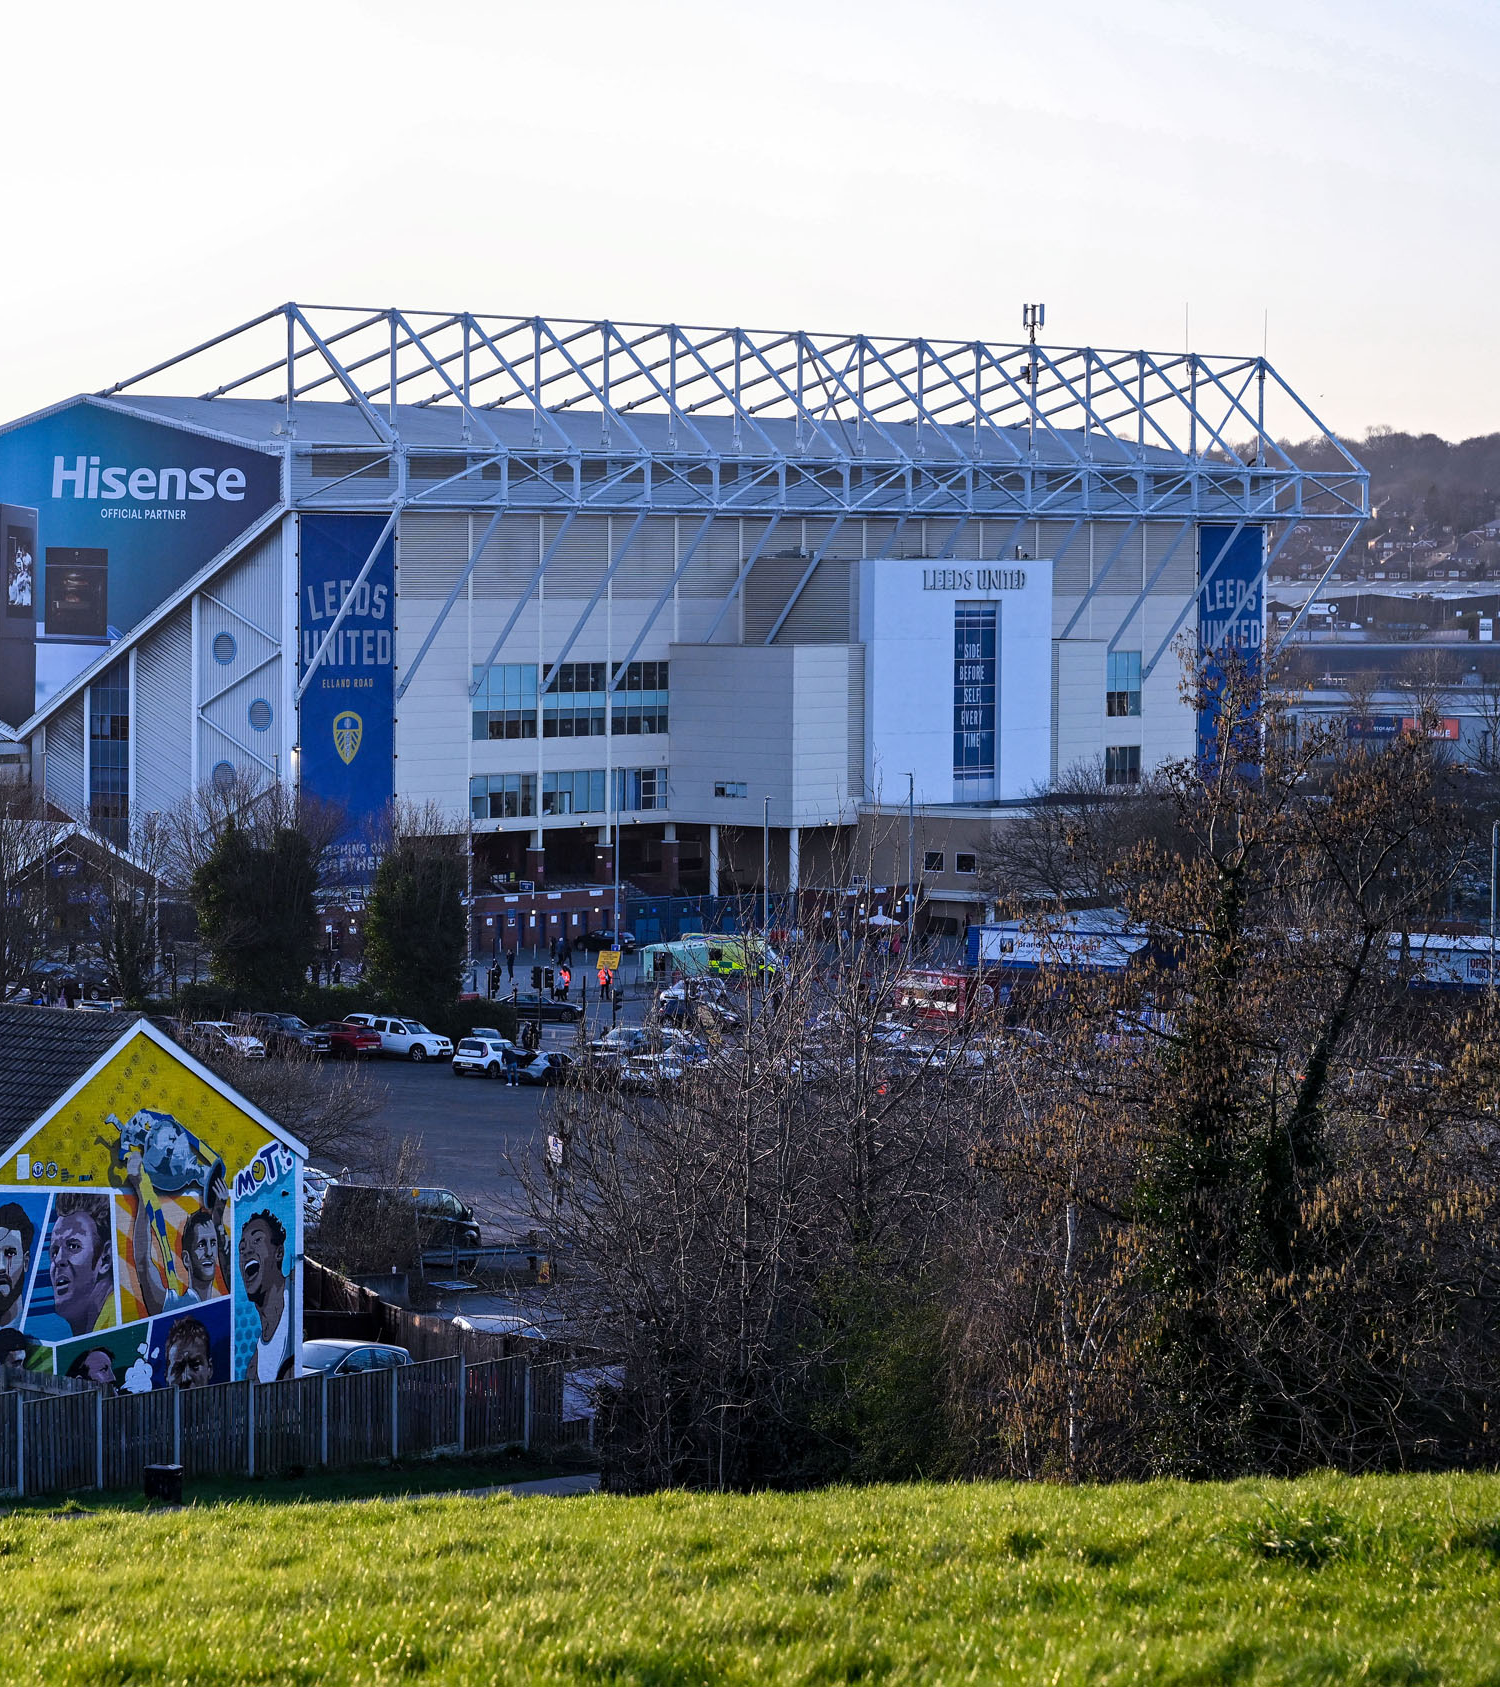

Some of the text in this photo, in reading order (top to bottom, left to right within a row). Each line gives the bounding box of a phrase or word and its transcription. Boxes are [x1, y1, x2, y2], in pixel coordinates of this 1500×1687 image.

[52, 455, 246, 502] Hisense
[100, 508, 187, 521] OFFICIAL PARTNER
[923, 569, 1028, 591] LEEDS UNITED
[307, 579, 389, 622] LEEDS
[1205, 578, 1258, 613] LEEDS
[303, 629, 391, 666] UNITED
[322, 678, 374, 689] ELLAND ROAD
[959, 665, 985, 681] BEFORE
[960, 710, 983, 726] EVERY
